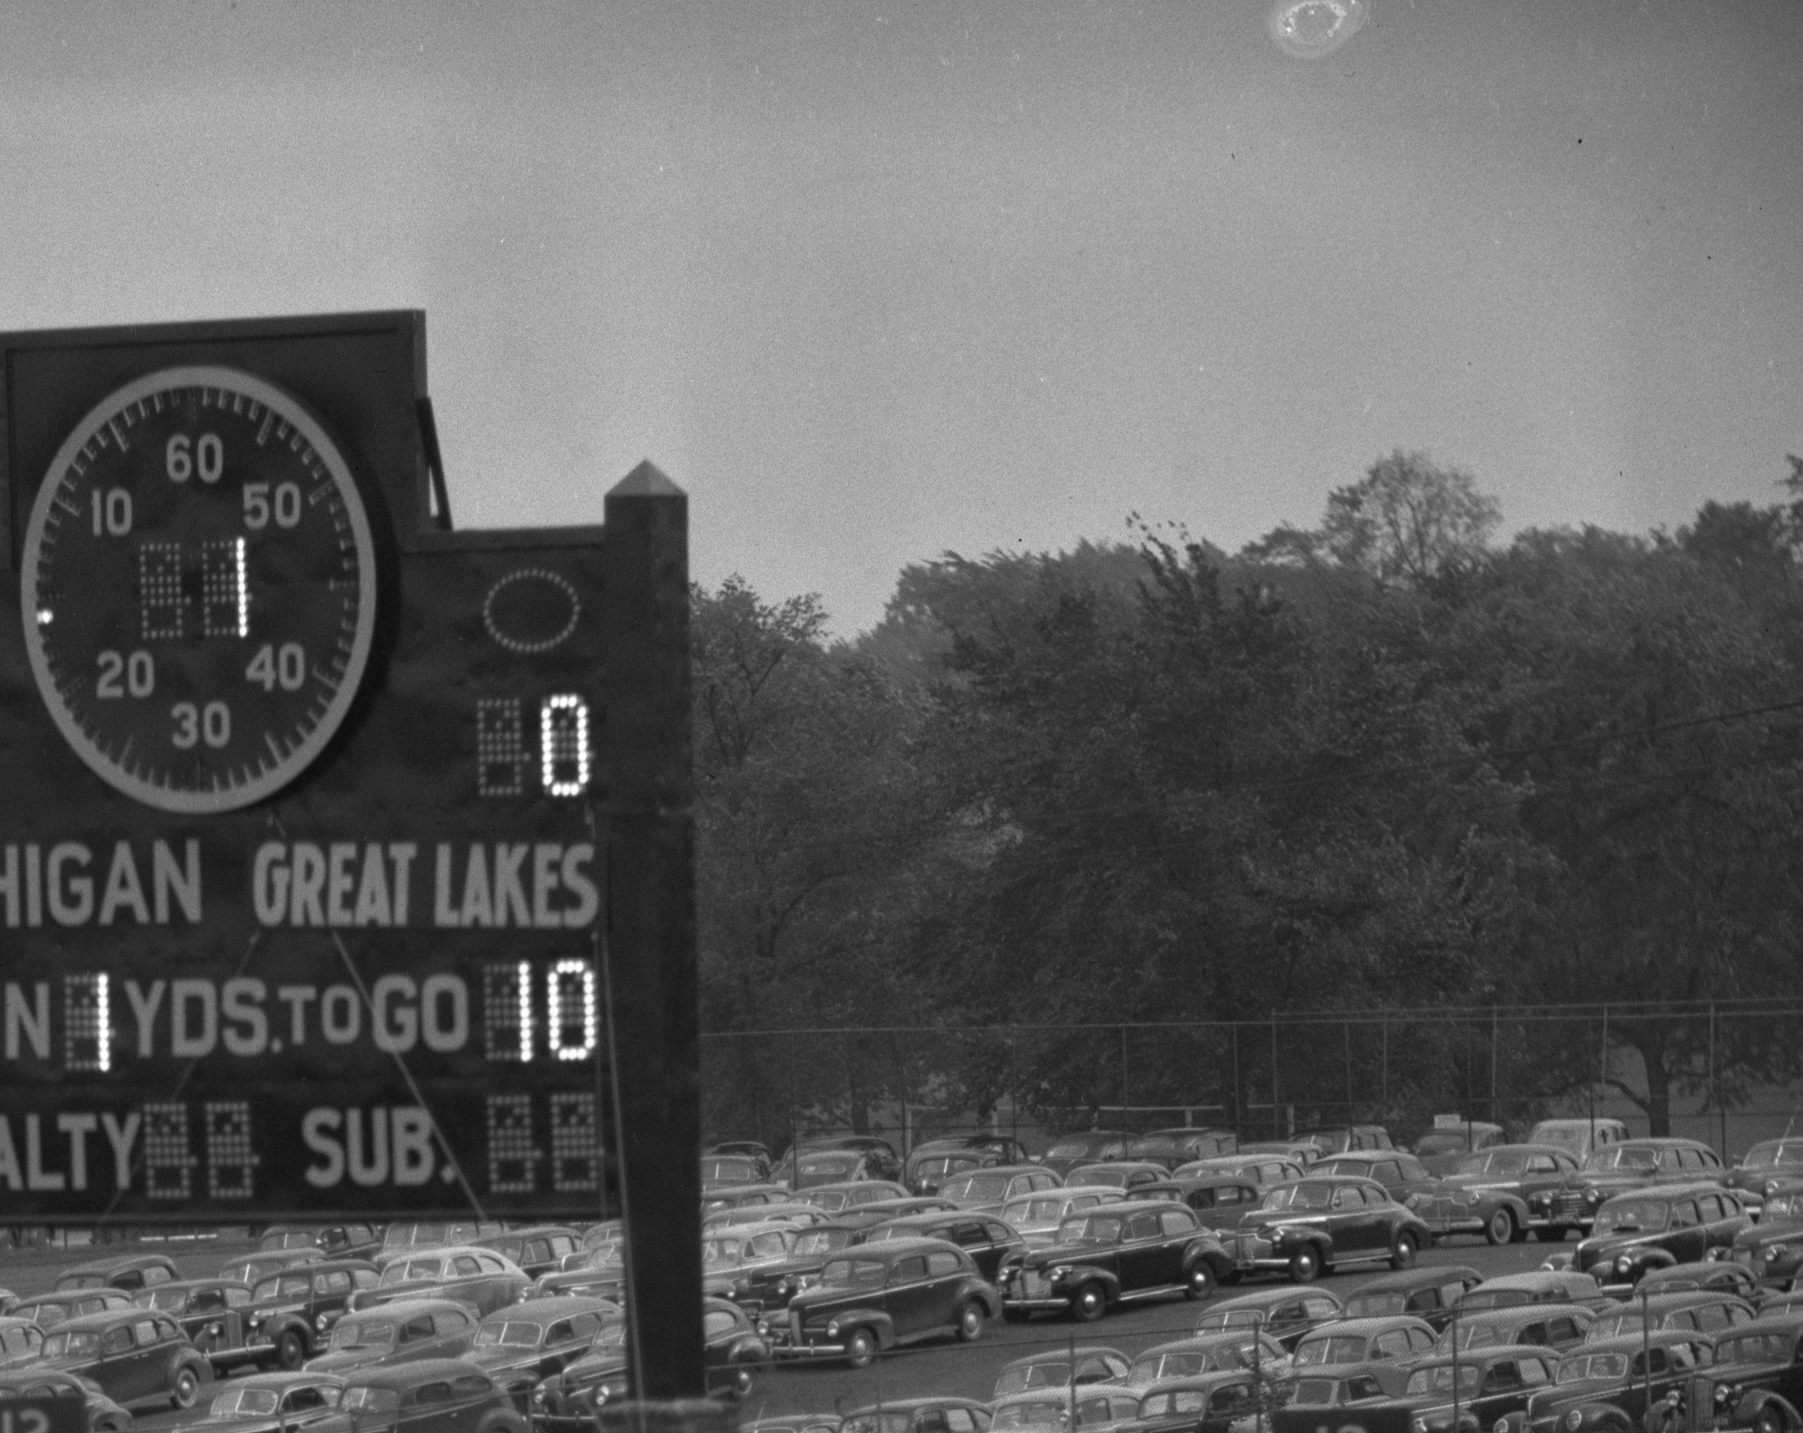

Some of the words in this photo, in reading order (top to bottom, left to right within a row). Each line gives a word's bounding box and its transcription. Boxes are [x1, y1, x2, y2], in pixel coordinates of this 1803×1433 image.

[166, 433, 224, 483] 60
[91, 488, 133, 536] 10
[243, 482, 301, 530] 50
[235, 537, 248, 637] 1
[96, 650, 155, 699] 20
[245, 642, 305, 691] 40
[171, 701, 231, 749] 30
[253, 842, 417, 926] GREAT
[434, 843, 599, 928] LAKES
[96, 973, 111, 1072] 1
[370, 973, 469, 1055] GO
[518, 960, 596, 1062] 10
[302, 1105, 459, 1187] SUB.
